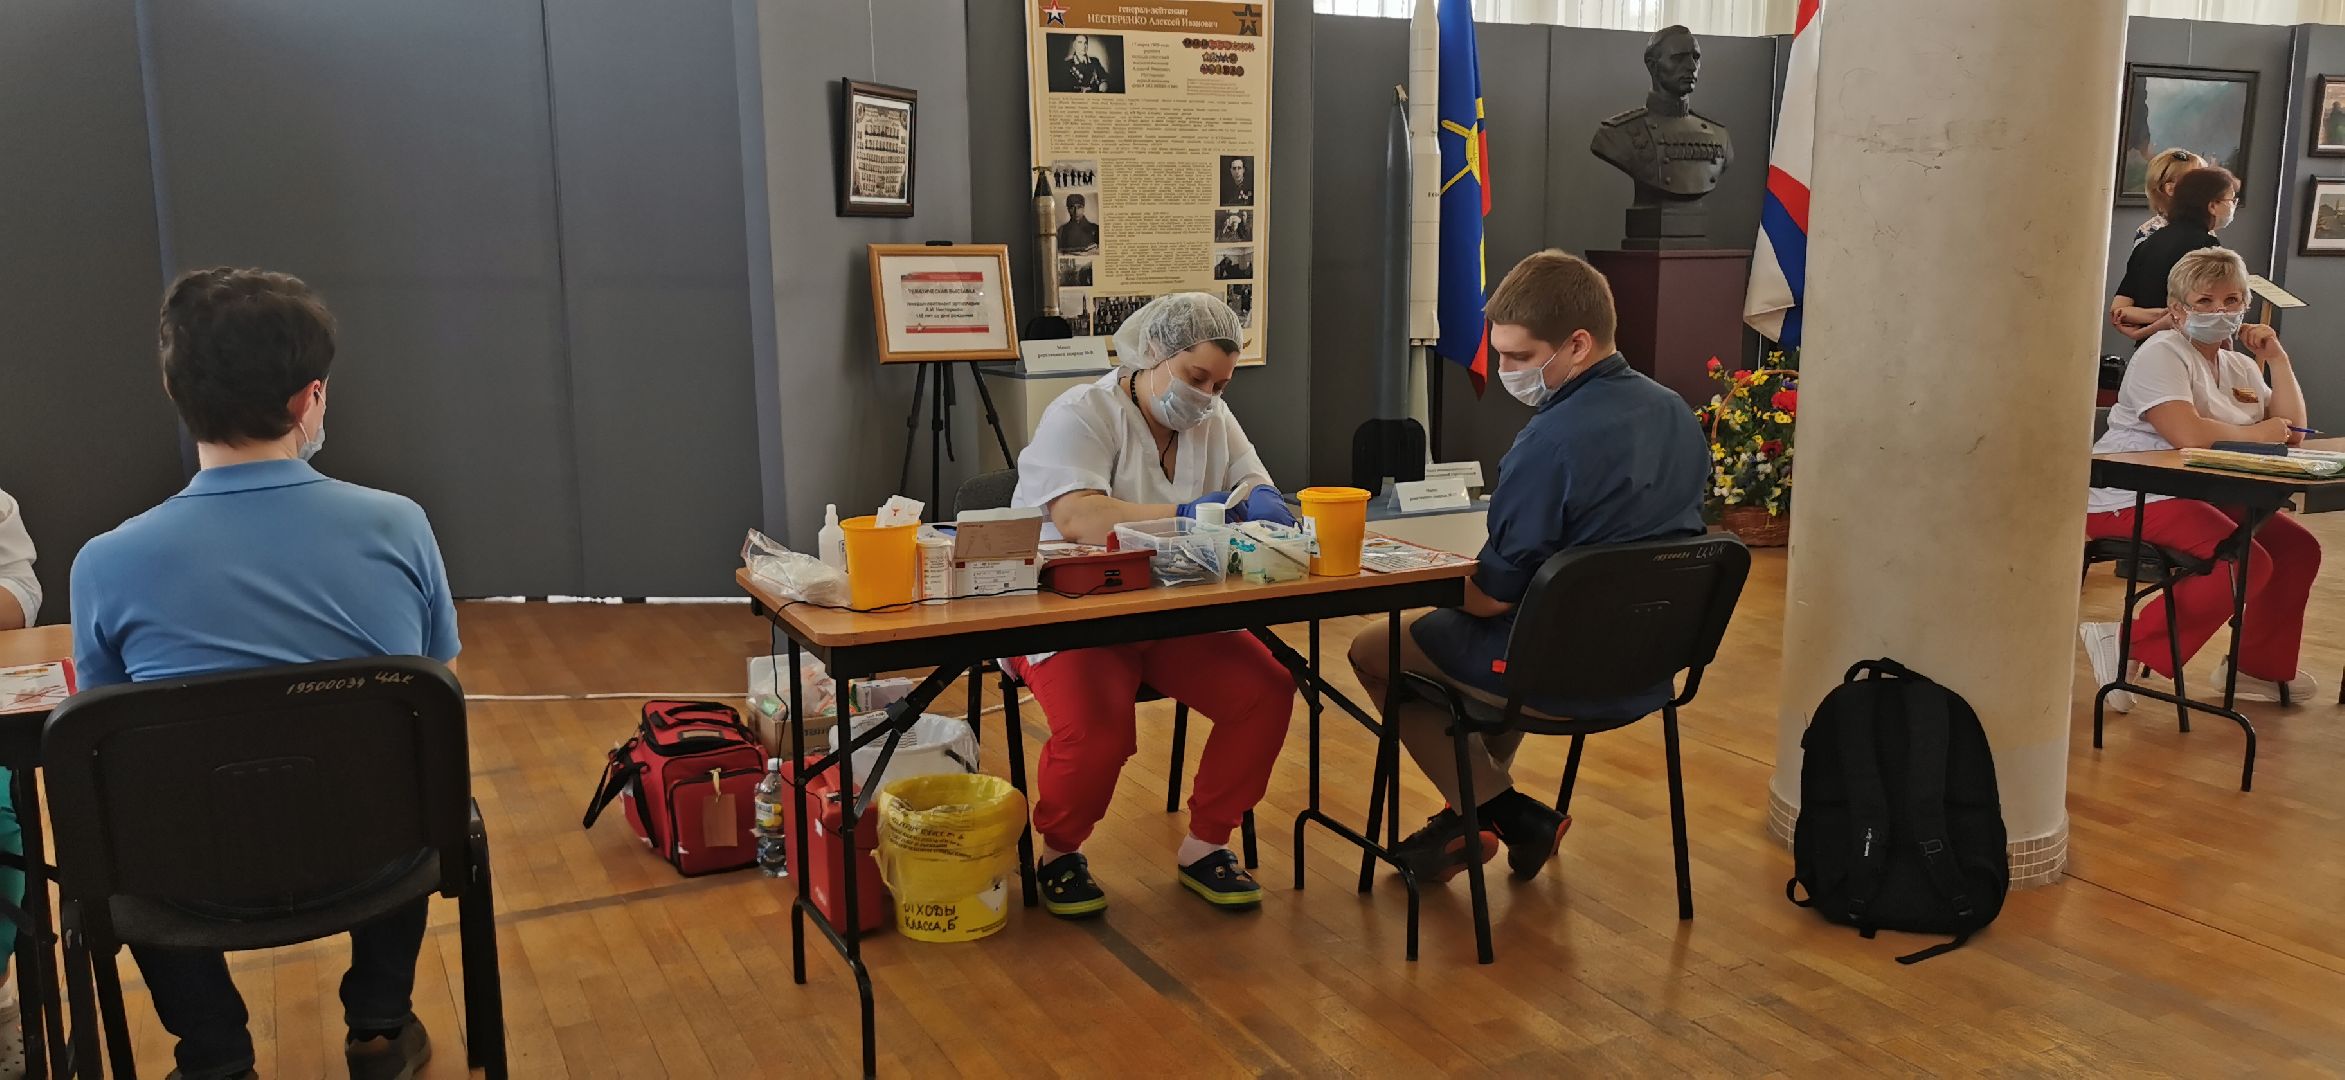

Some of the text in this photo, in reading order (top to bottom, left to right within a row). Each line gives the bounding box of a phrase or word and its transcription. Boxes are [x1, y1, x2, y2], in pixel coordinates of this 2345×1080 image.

[1087, 13, 1218, 28] НЕСТЕРЕНКО Алексей Иванович
[904, 915, 942, 932] КЛАССА
